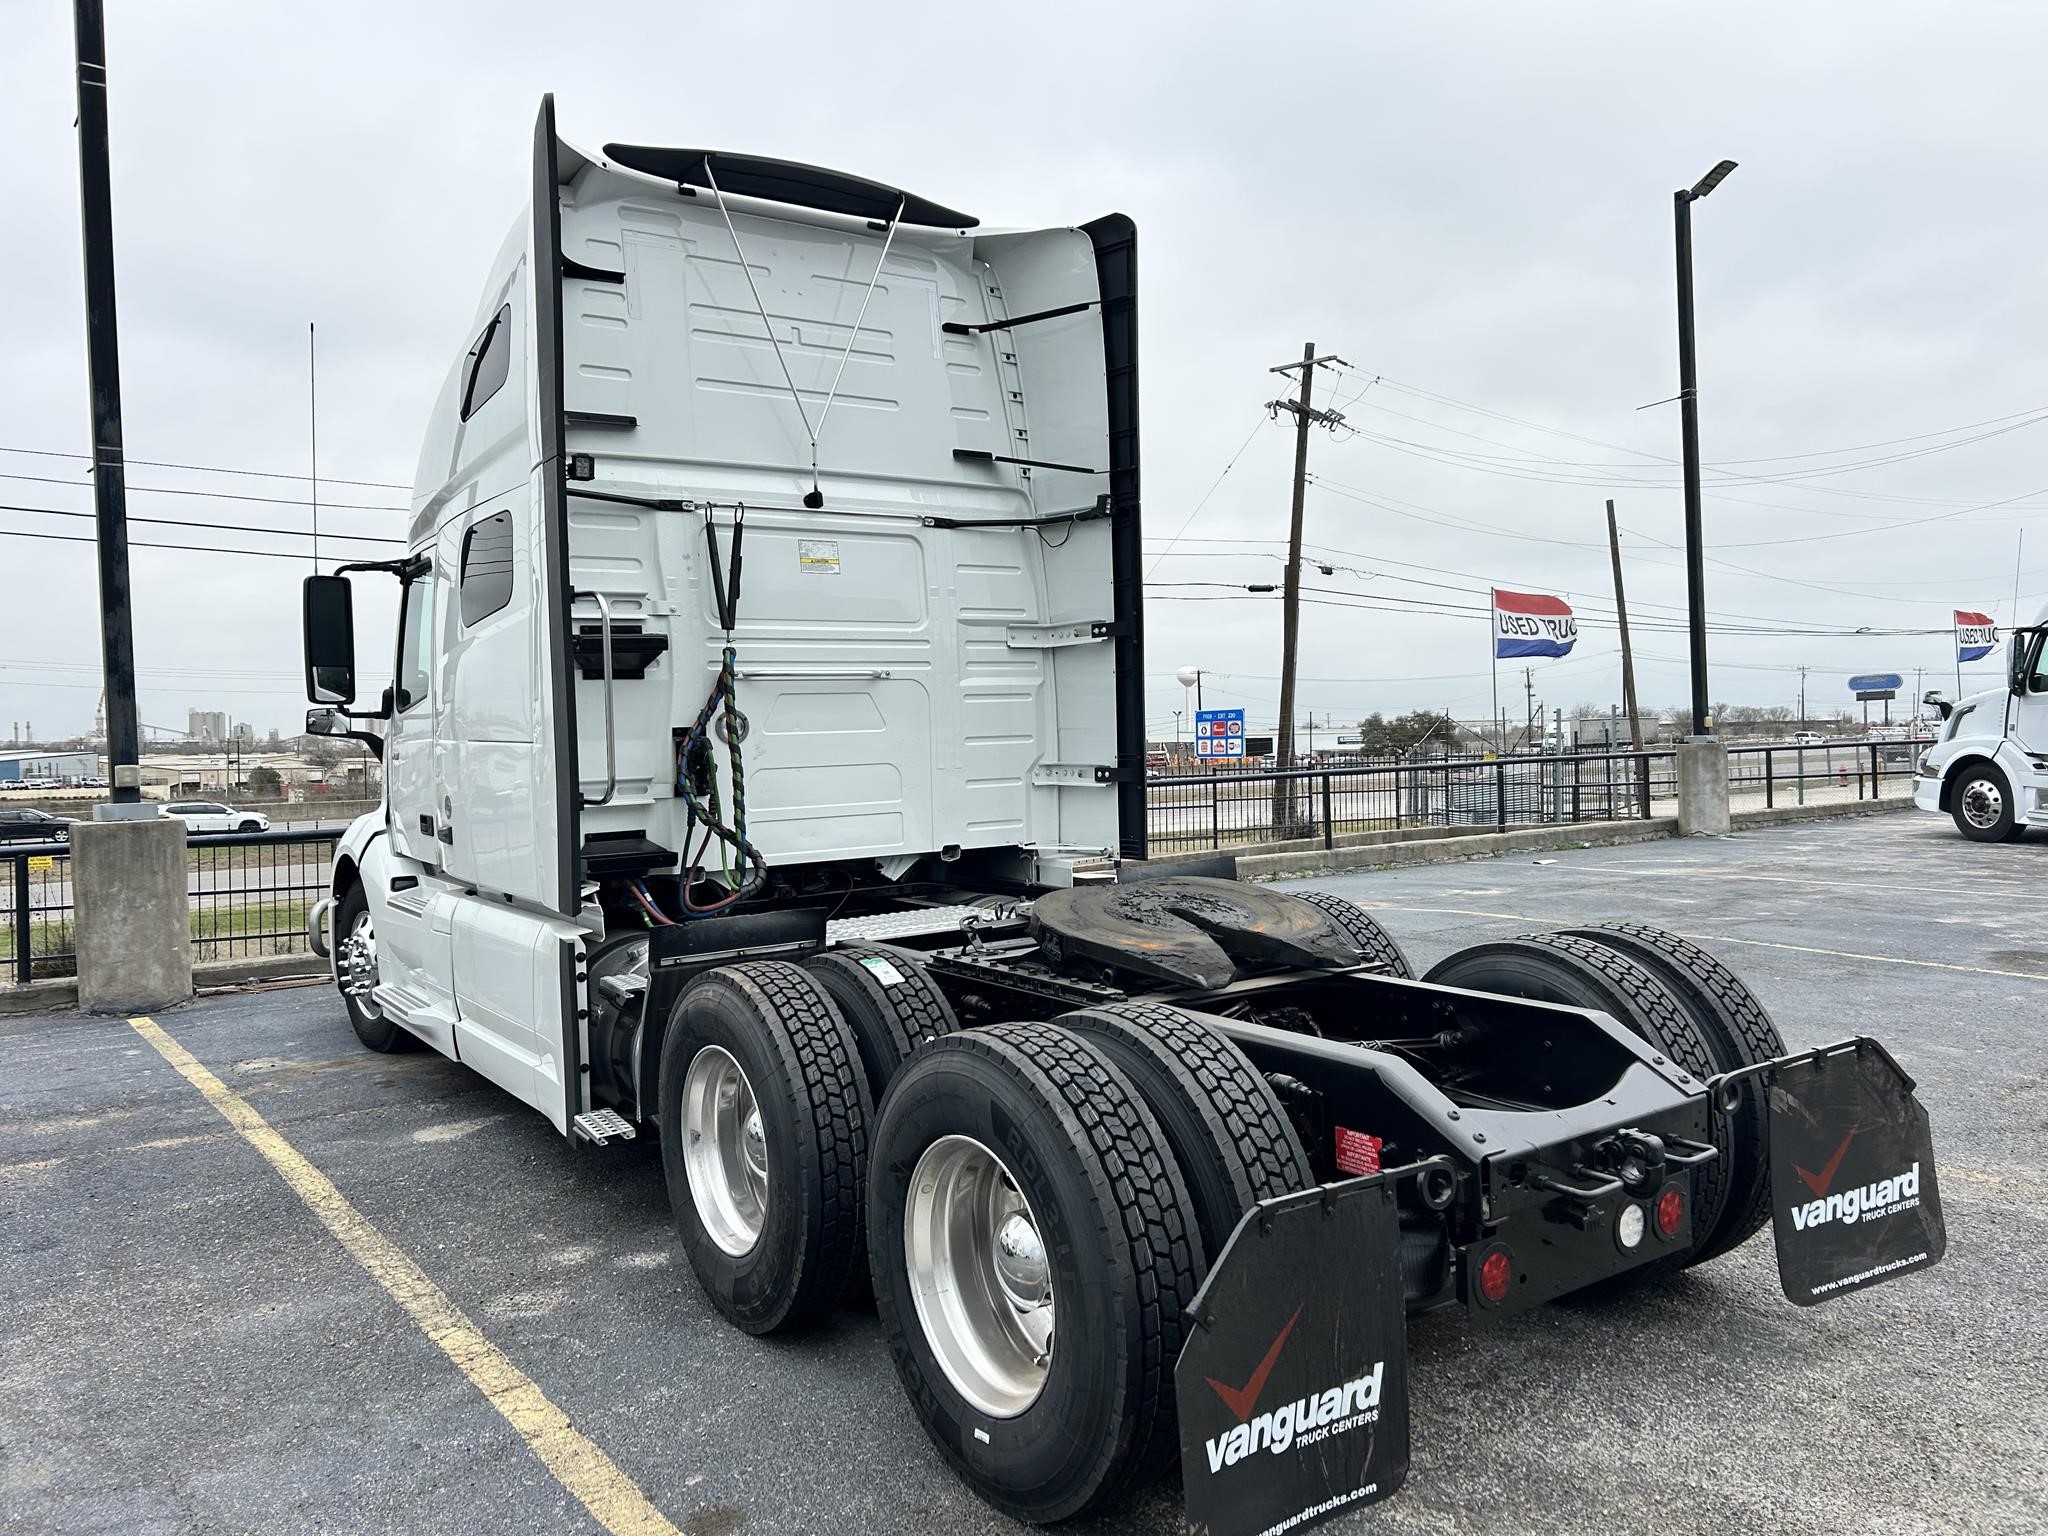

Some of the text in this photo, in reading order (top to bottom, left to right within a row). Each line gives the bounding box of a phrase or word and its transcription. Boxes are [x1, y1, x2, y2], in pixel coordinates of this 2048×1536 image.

[1500, 613, 1540, 636] USED
[1791, 1162, 1920, 1231] vanguard
[1861, 1197, 1920, 1223] TRUCK CENTERS
[1811, 1251, 1928, 1296] www.vanguardtrucks.com
[1206, 1362, 1384, 1474] vanguard
[1295, 1408, 1379, 1450] TRUCK CENTERS
[1256, 1483, 1377, 1536] anguardtrucks.com
